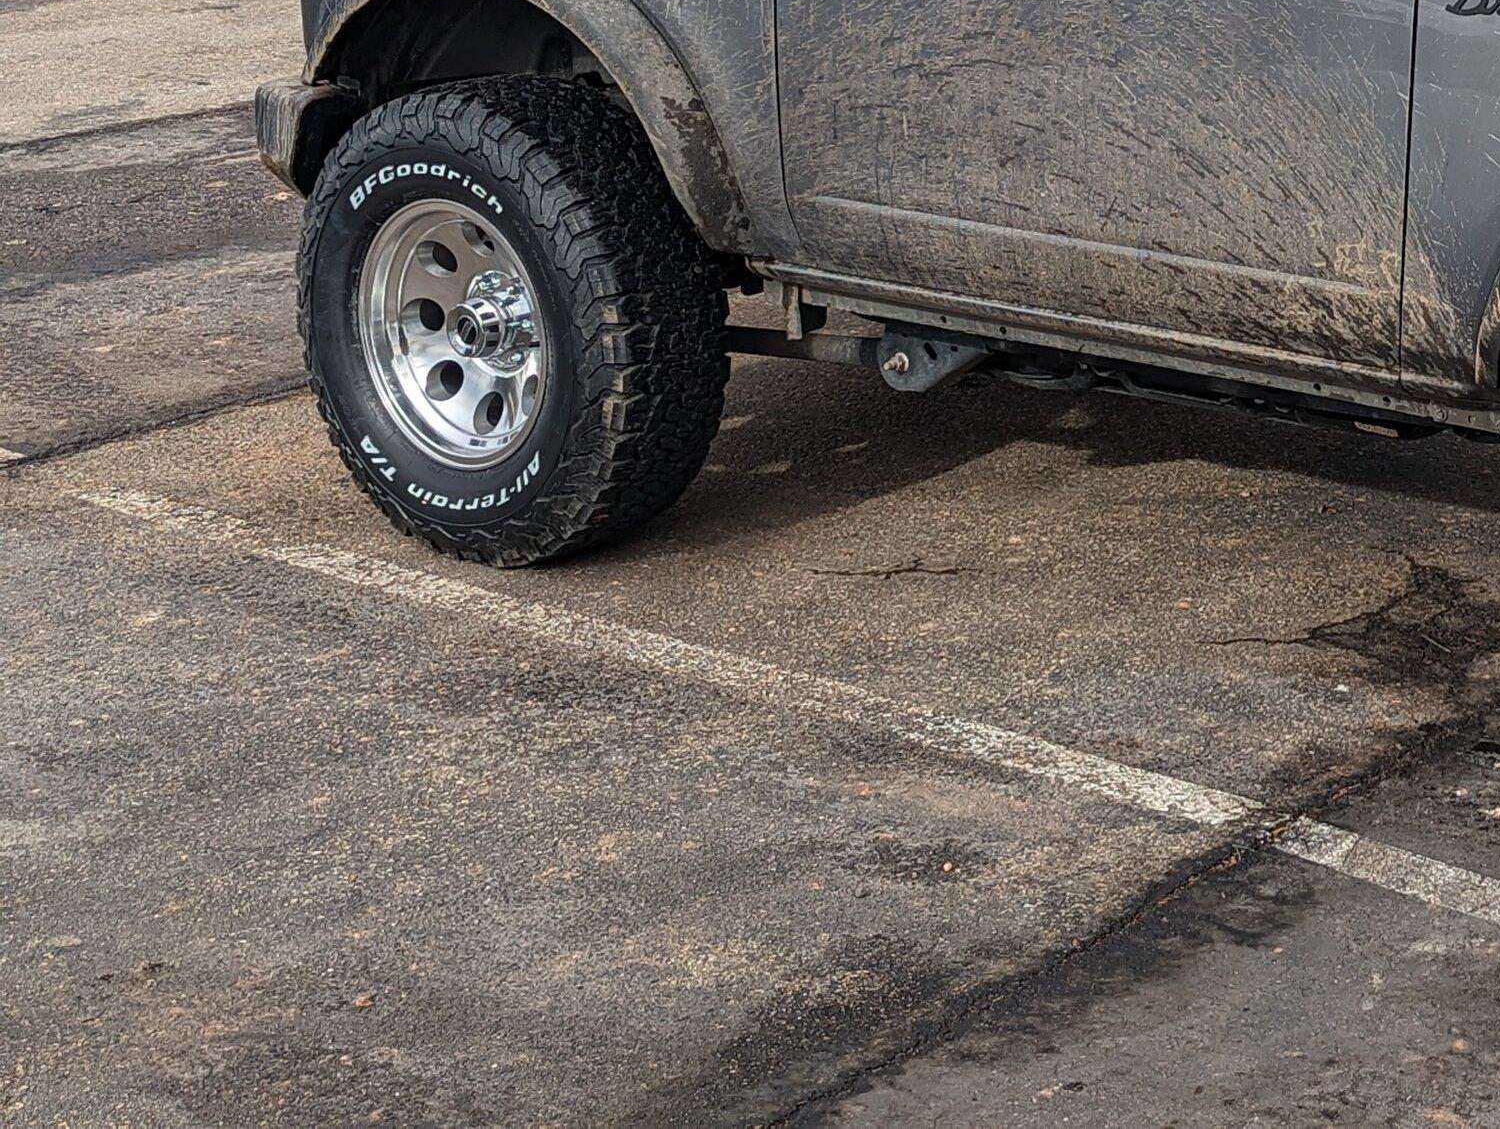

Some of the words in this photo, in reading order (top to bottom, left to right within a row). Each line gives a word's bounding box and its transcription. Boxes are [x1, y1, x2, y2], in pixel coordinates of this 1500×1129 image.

[348, 162, 504, 214] BFGoodrich
[360, 434, 397, 483] T/A
[406, 450, 541, 510] All-Terrain
